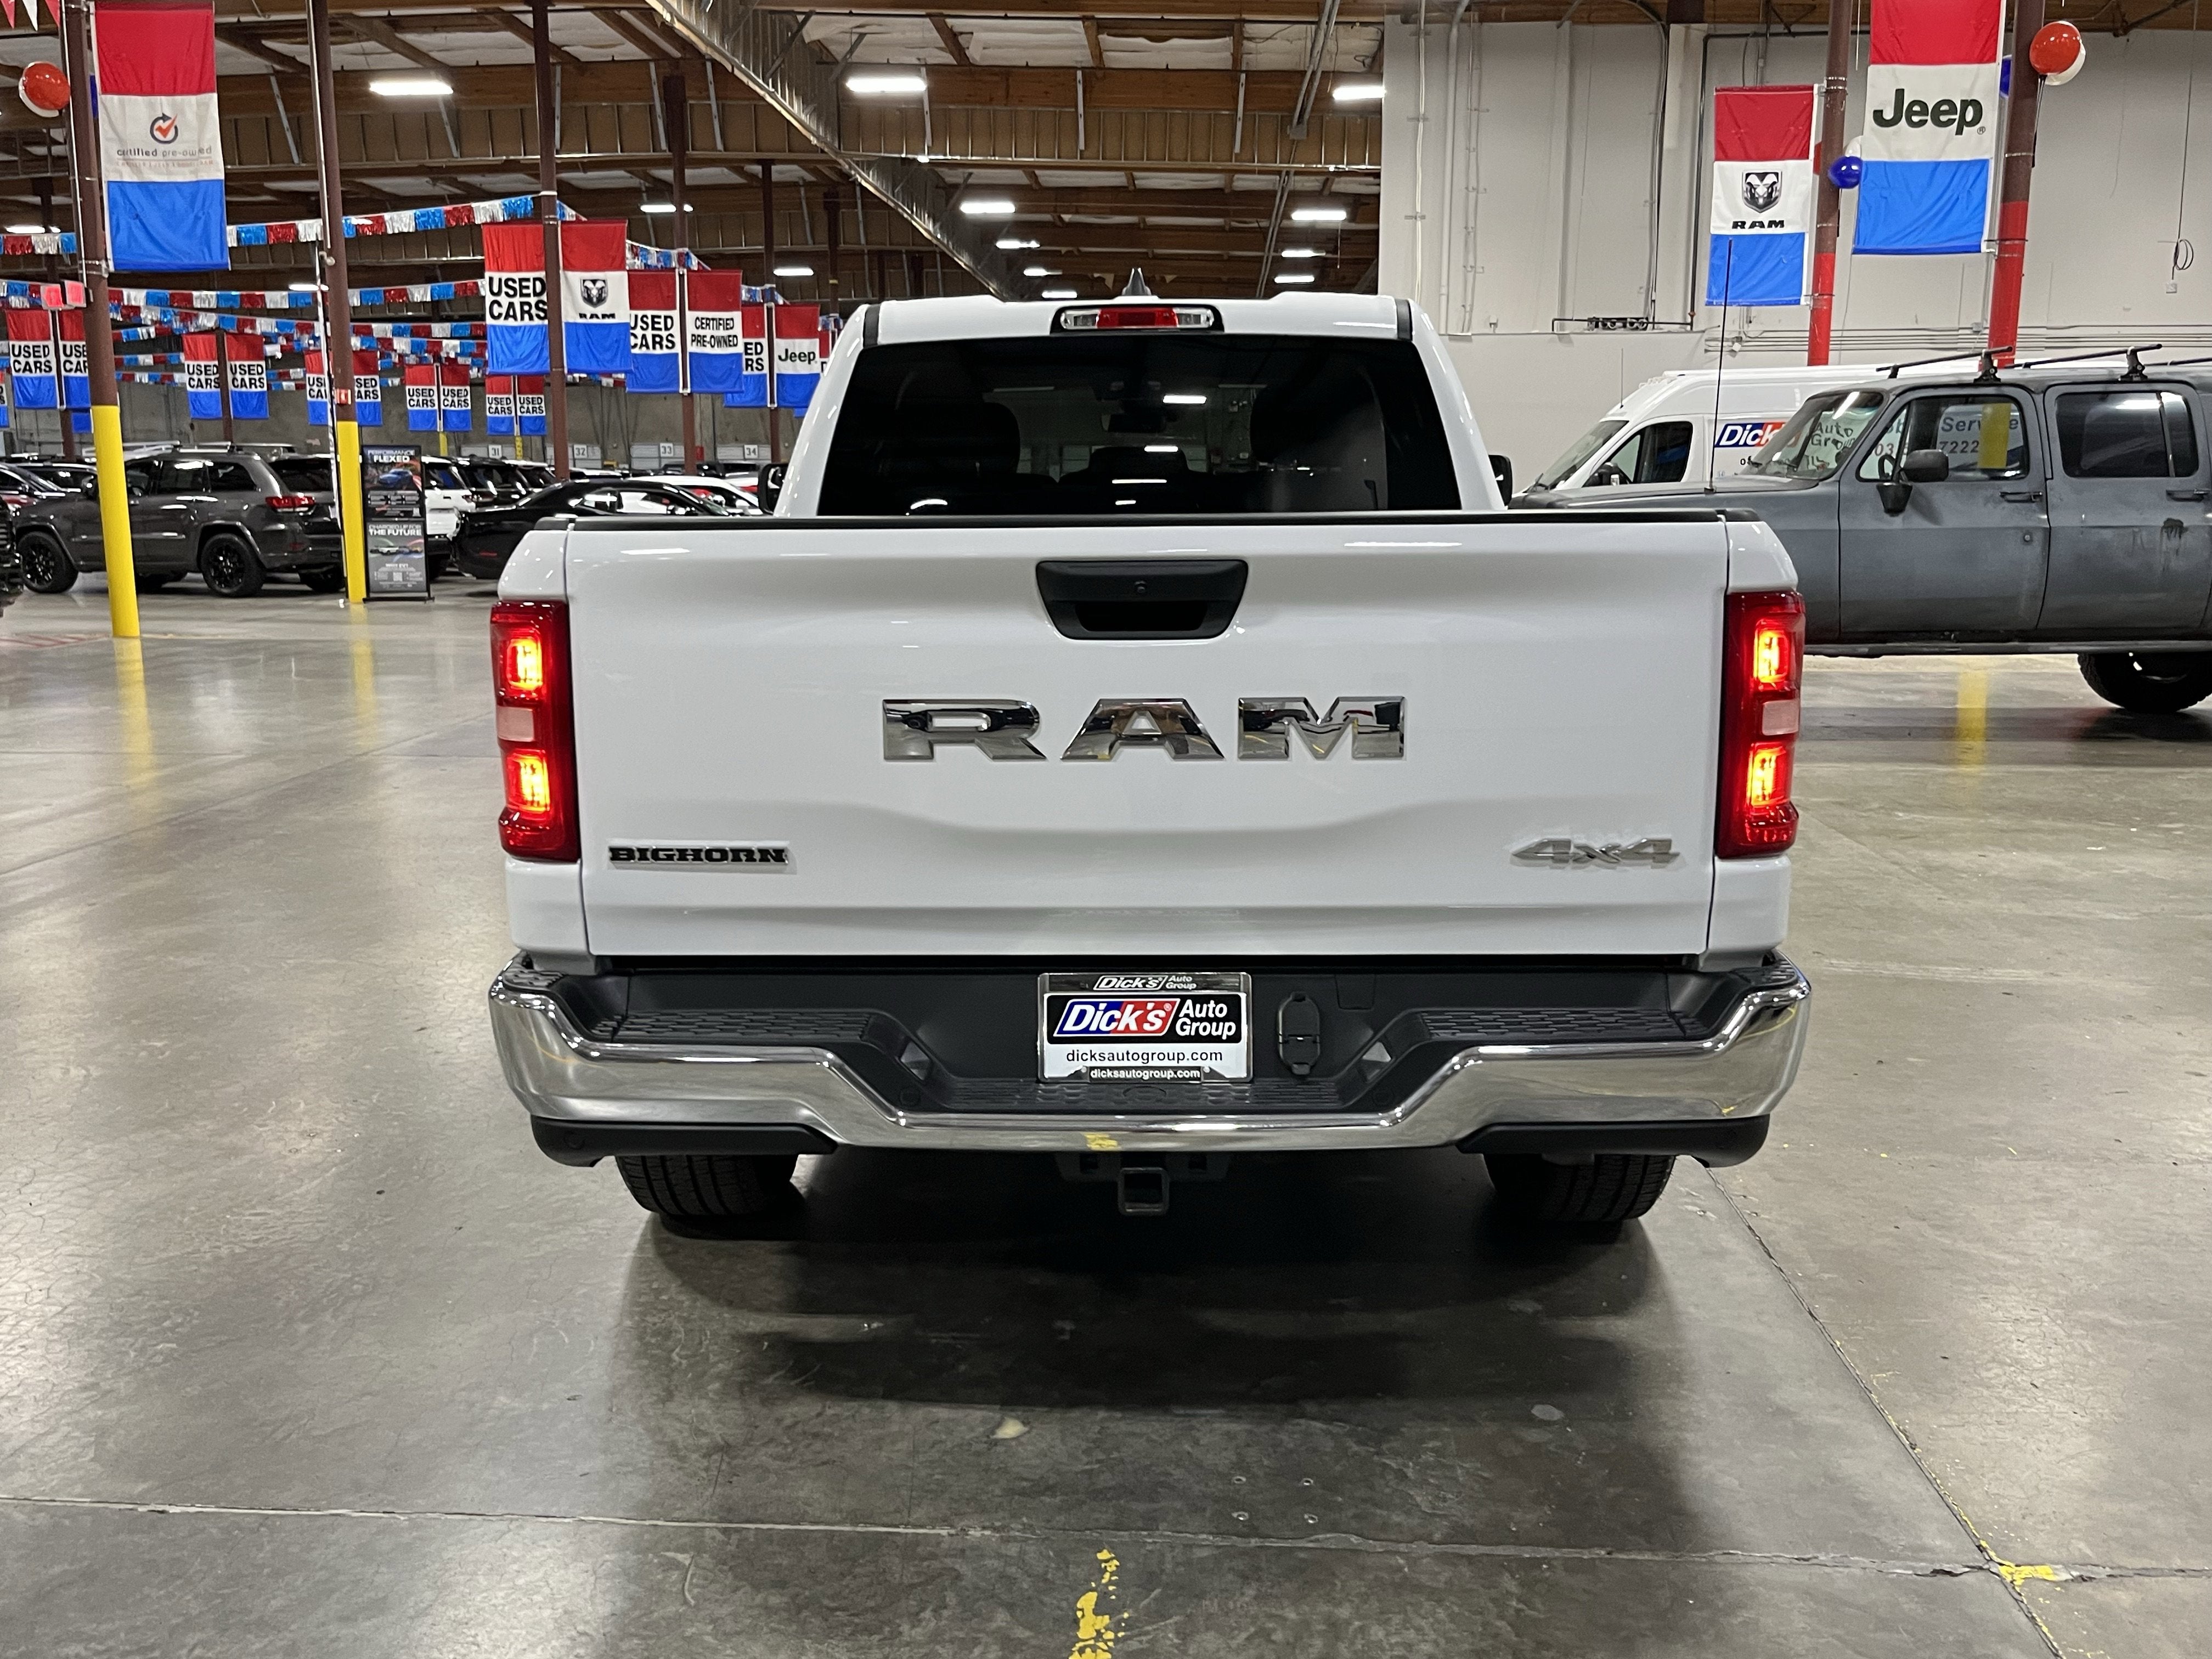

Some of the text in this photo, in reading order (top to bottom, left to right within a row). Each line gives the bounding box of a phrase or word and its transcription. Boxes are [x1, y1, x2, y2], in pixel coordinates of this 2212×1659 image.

[1872, 88, 1983, 136] Jeep
[162, 145, 212, 157] pre-owed
[1731, 220, 1785, 229] RAM
[488, 276, 546, 298] USED
[489, 300, 548, 321] CARS
[695, 317, 735, 330] CERTIFIED
[691, 334, 738, 348] PRE-OWNED
[12, 344, 50, 358] USED
[744, 342, 764, 356] ED
[778, 348, 816, 364] Jeep
[13, 360, 53, 373] CARS
[63, 360, 88, 373] CAR
[187, 364, 218, 375] USED
[230, 364, 264, 375] USED
[744, 358, 764, 371] RS
[188, 377, 219, 388] CARS
[232, 377, 264, 388] CARS
[308, 376, 326, 387] US
[356, 377, 377, 388] SED
[308, 388, 327, 399] CA
[357, 389, 379, 400] ARS
[408, 388, 435, 397] USED
[443, 388, 469, 398] USED
[408, 398, 436, 408] CARS
[443, 399, 469, 408] CARS
[488, 397, 512, 405] USED
[519, 397, 543, 405] USED
[488, 406, 512, 415] CARS
[519, 406, 544, 415] CARS
[1814, 421, 1853, 438] Auto
[1941, 416, 2019, 433] Sere
[1719, 424, 1783, 446] Dick
[575, 448, 585, 456] 32
[662, 445, 672, 454] 33
[746, 447, 757, 456] 34
[883, 697, 1406, 760] RAM
[609, 847, 788, 863] BIGHORN
[1098, 977, 1160, 988] Dick's
[1166, 981, 1197, 990] Group
[1178, 1000, 1228, 1018] Auto
[1062, 1002, 1165, 1031] Dick's
[1175, 1018, 1236, 1040] Group
[1066, 1049, 1223, 1064] dicksautogroup.com
[1090, 1068, 1201, 1079] dicksautogroup.com
